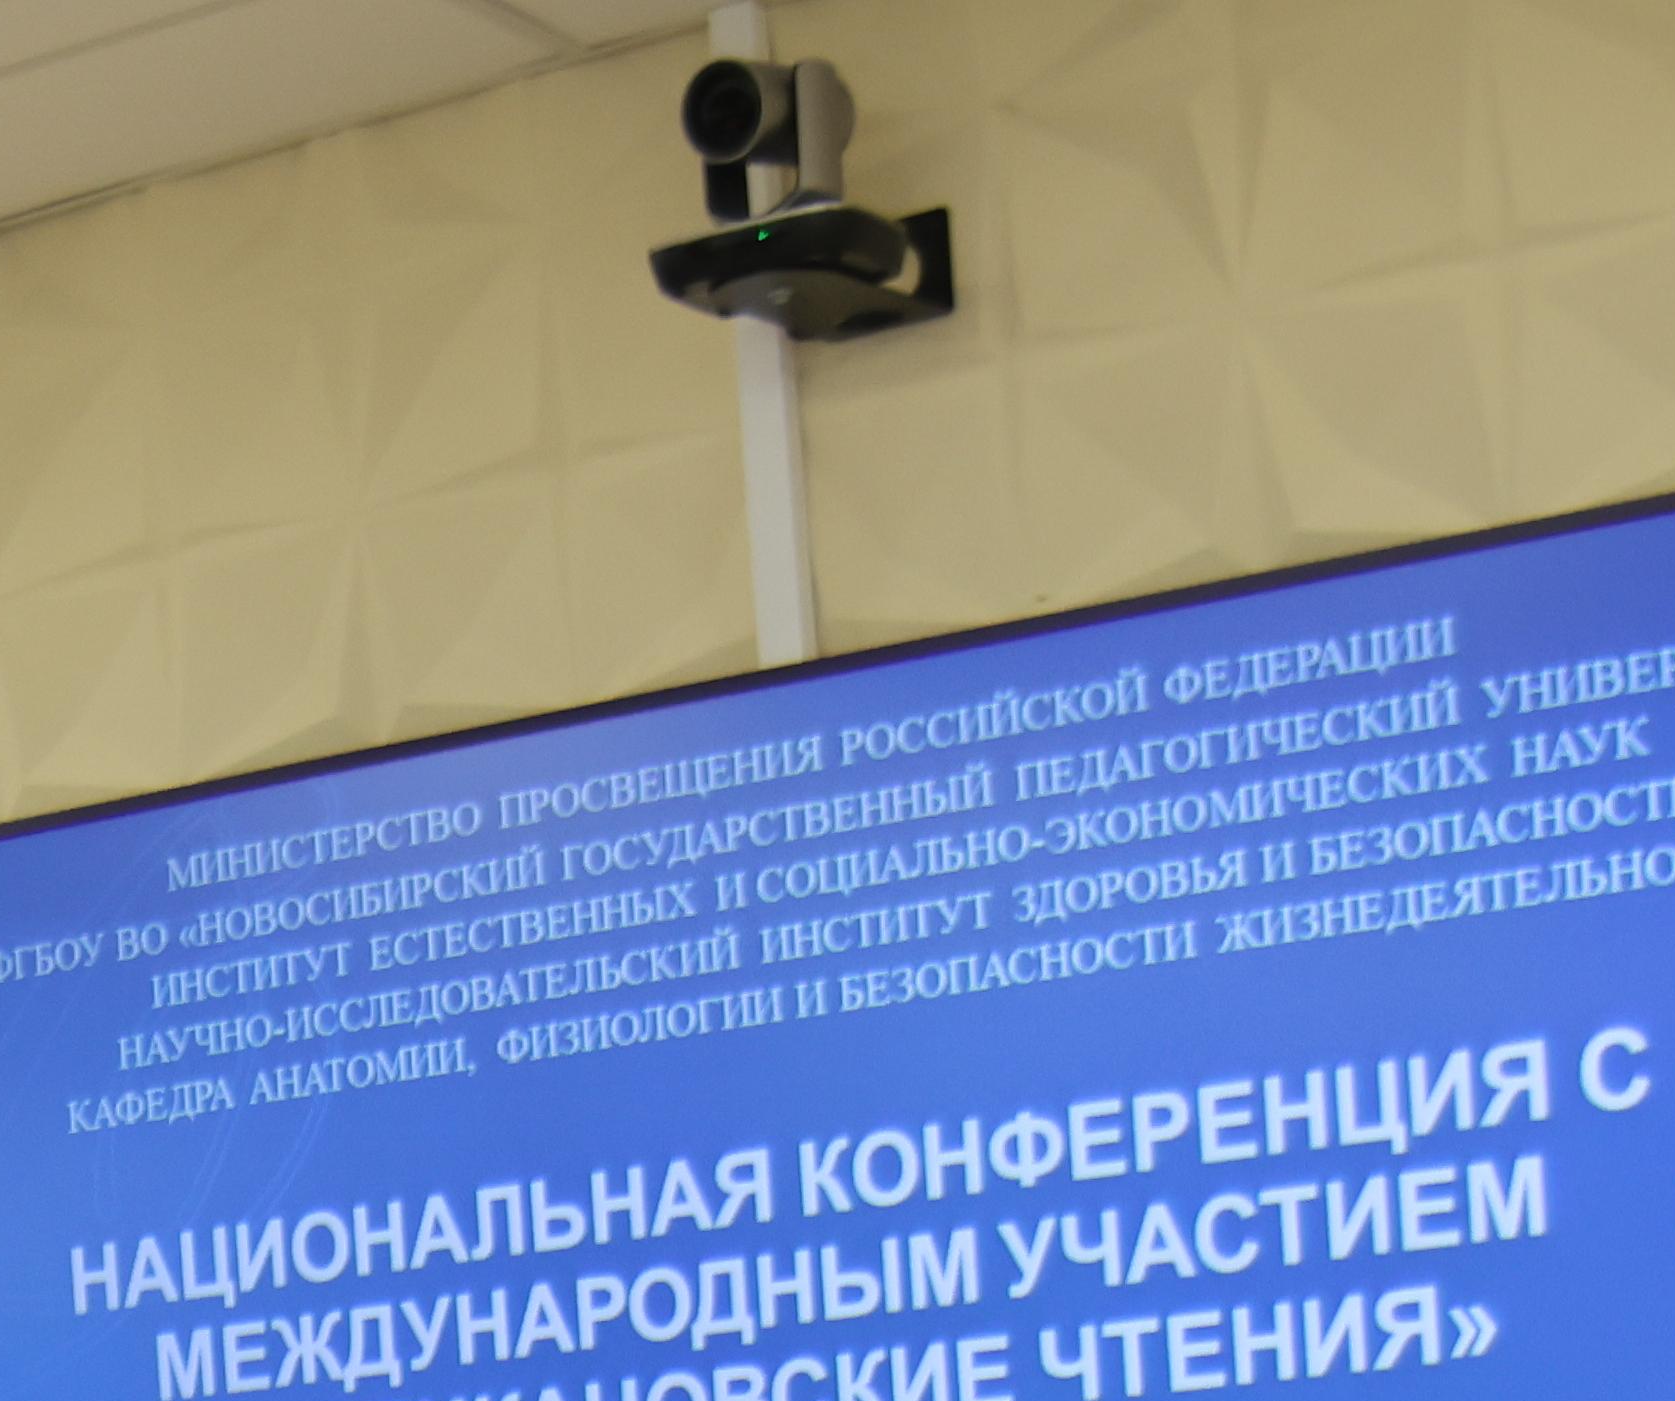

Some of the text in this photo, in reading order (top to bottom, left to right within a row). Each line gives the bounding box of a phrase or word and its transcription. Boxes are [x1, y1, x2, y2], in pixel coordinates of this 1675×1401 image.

[115, 920, 168, 962] ВО
[178, 842, 547, 951] «НОВОСИБИРСКИЙ
[560, 762, 993, 883] ГОСУДАРСТВЕННЫЙ
[1015, 681, 1461, 802] ПЕДАГОГИЧЕСКИЙ
[151, 717, 1651, 1008] ИНСТИТУТ ЕСТЕСТВЕННЫХ И СОЦИАЛЬНО-ЭКОНОМИЧЕСКИХ НАУК
[165, 617, 1457, 892] МИНИСТЕРСТВО ПРОСВЕЩЕНИЯ РОССИЙСКОЙ ФЕДЕРАЦИИ
[67, 1077, 233, 1134] КАФЕДРА
[249, 1040, 475, 1105] АНАТОМИИ,
[495, 986, 784, 1065] ФИЗИОЛОГИИ
[797, 980, 829, 1016] И
[839, 919, 1197, 1012] БЕЗОПАСНОСТИ
[118, 928, 740, 1070] НАУЧНО-ИССЛЕДОВАТЕЛЬСКИЙ
[760, 892, 990, 964] ИНСТИТУТ
[1012, 846, 1248, 928] ЗДОРОВЬЯ
[1261, 842, 1295, 882] И
[68, 1027, 1649, 1316] НАЦИОНАЛЬНАЯ КОНФЕРЕНЦИЯ С
[1006, 1155, 1548, 1306] УЧАСТИЕМ
